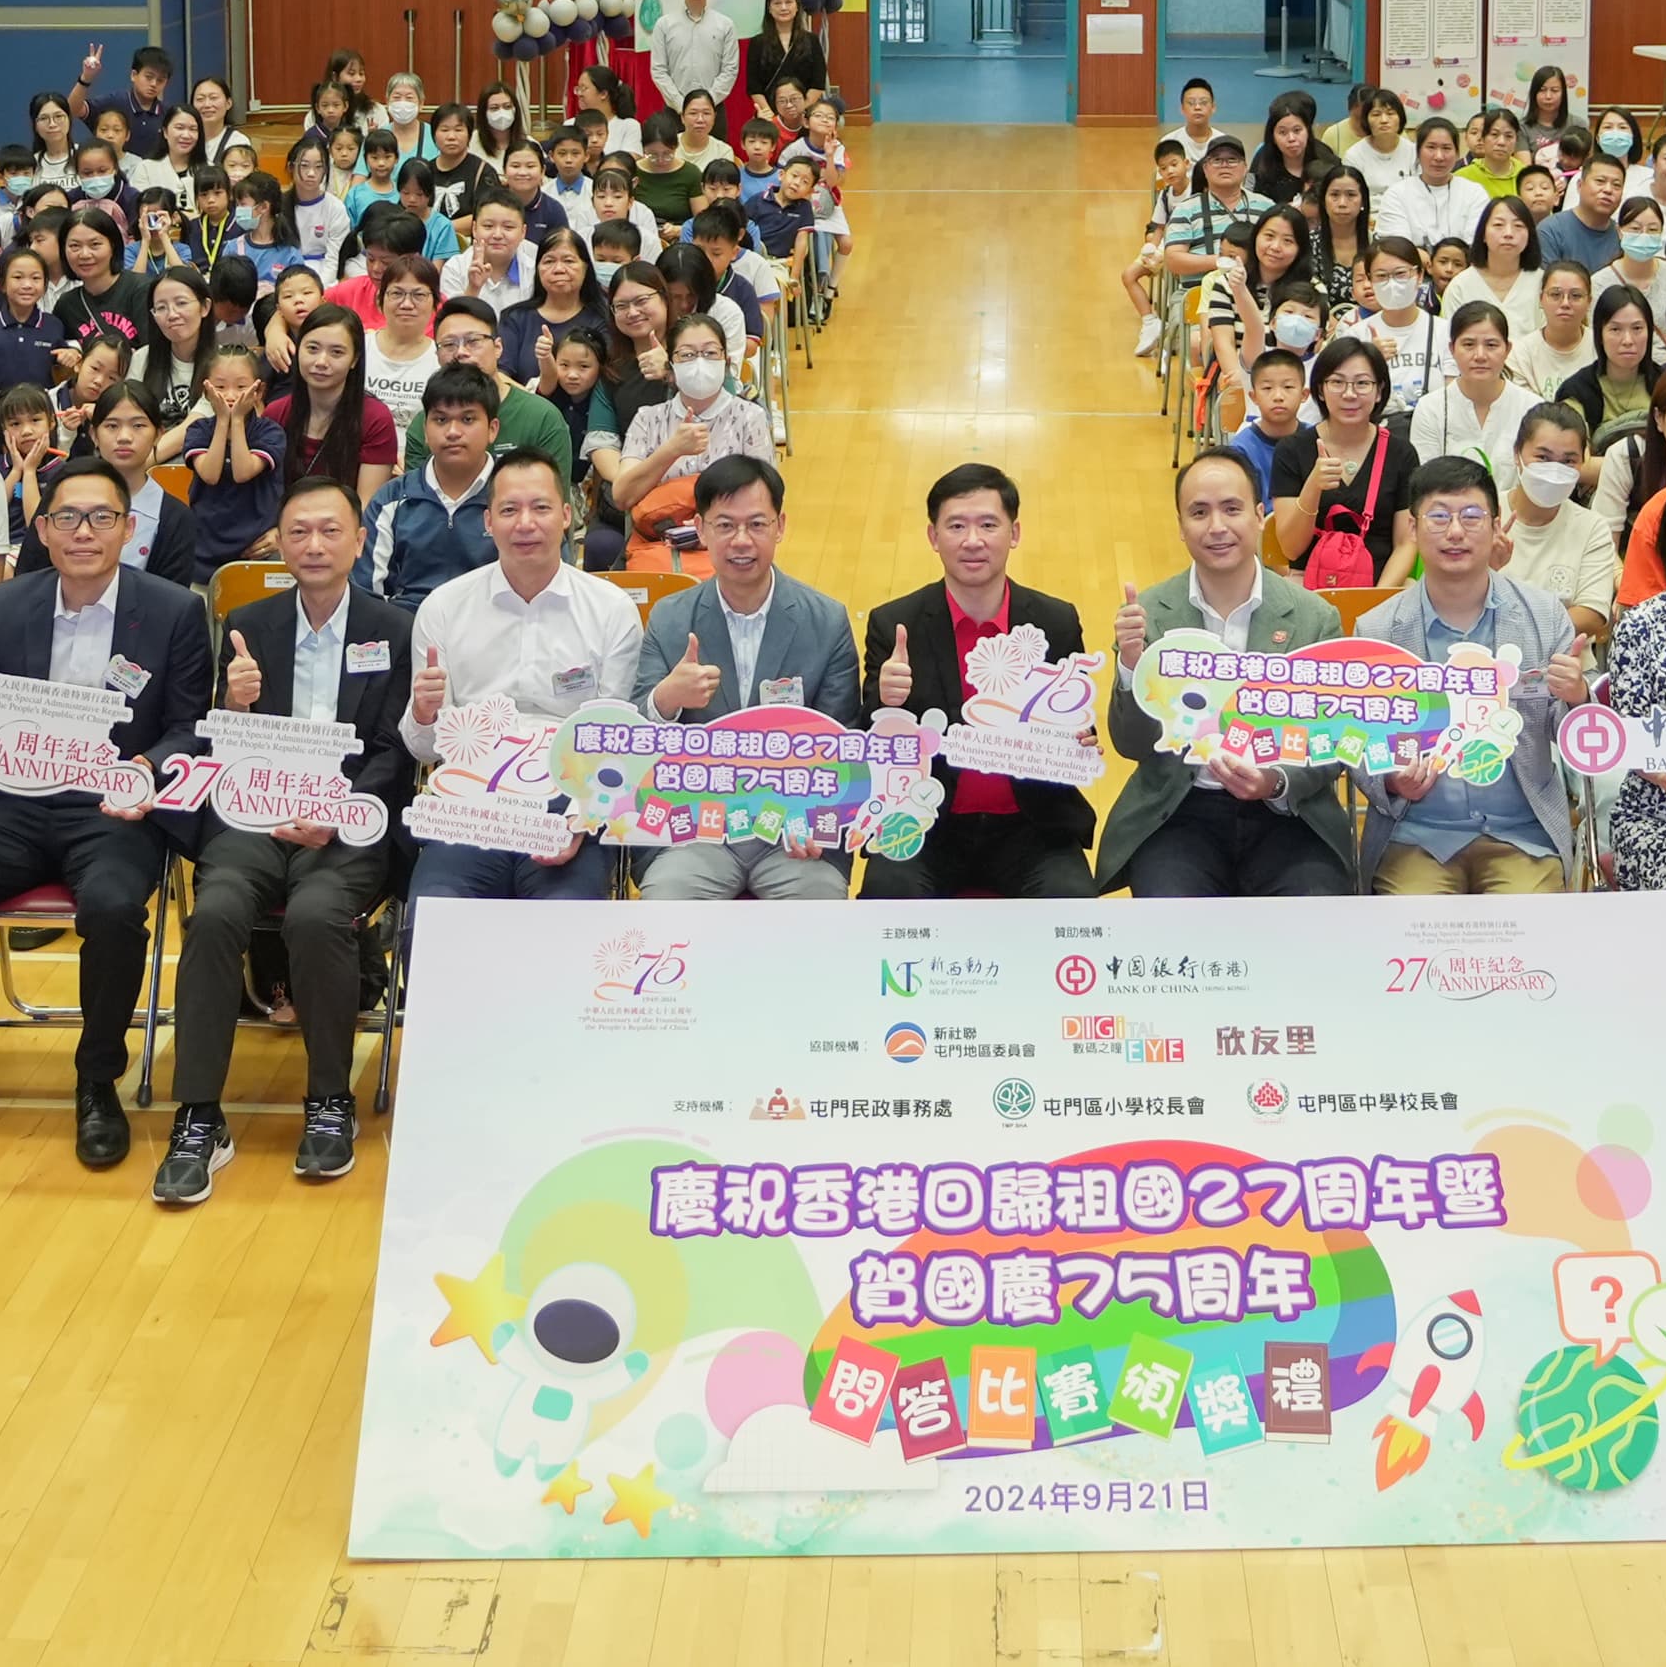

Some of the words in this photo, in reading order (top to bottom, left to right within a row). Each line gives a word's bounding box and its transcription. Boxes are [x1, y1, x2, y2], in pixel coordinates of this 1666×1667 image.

[367, 376, 424, 393] VOGUE
[1160, 649, 1498, 695] 慶祝香港回歸祖國27周年暨
[1019, 656, 1101, 723] 75
[1237, 689, 1418, 724] 賀國慶75周年
[210, 715, 351, 739] 中華人民共和國香港特別行政區
[15, 731, 114, 766] 周年紀念
[575, 723, 920, 765] 慶祝香港回歸祖國27周年暨
[247, 767, 347, 799] 周年紀念
[655, 763, 838, 795] 賀國慶75周年
[227, 790, 372, 826] ANNIVERSARY
[496, 796, 543, 810] 1949-2024
[416, 826, 431, 834] the
[473, 834, 514, 847] Republic
[528, 840, 554, 852] China
[493, 824, 508, 834] the
[511, 827, 555, 842] Founding
[633, 939, 691, 996] 75
[931, 956, 1000, 978] 新西動力
[1449, 956, 1525, 974] 周年紀念
[1108, 985, 1139, 994] BANK
[1142, 985, 1157, 994] OF
[1160, 984, 1199, 994] CHINA
[1438, 973, 1547, 992] ANNIVERSARY
[934, 1027, 977, 1040] 新社聯
[1216, 1025, 1317, 1056] 欣友里
[934, 1044, 1036, 1058] 屯門地區委員會
[1072, 1042, 1122, 1054] 數碼之瞳
[1126, 1038, 1184, 1063] EYE
[810, 1098, 953, 1118] 屯門民政事務處
[1043, 1095, 1206, 1117] 屯門區小學校長會
[1297, 1092, 1459, 1113] 屯門區中學校長會
[651, 1154, 1506, 1237] 慶祝香港回歸祖國27周年暨
[851, 1245, 1314, 1327] 賀國慶75周年
[828, 1356, 1326, 1437] 問答比賽頒獎禮
[963, 1479, 1210, 1514] 2024年9月21日
